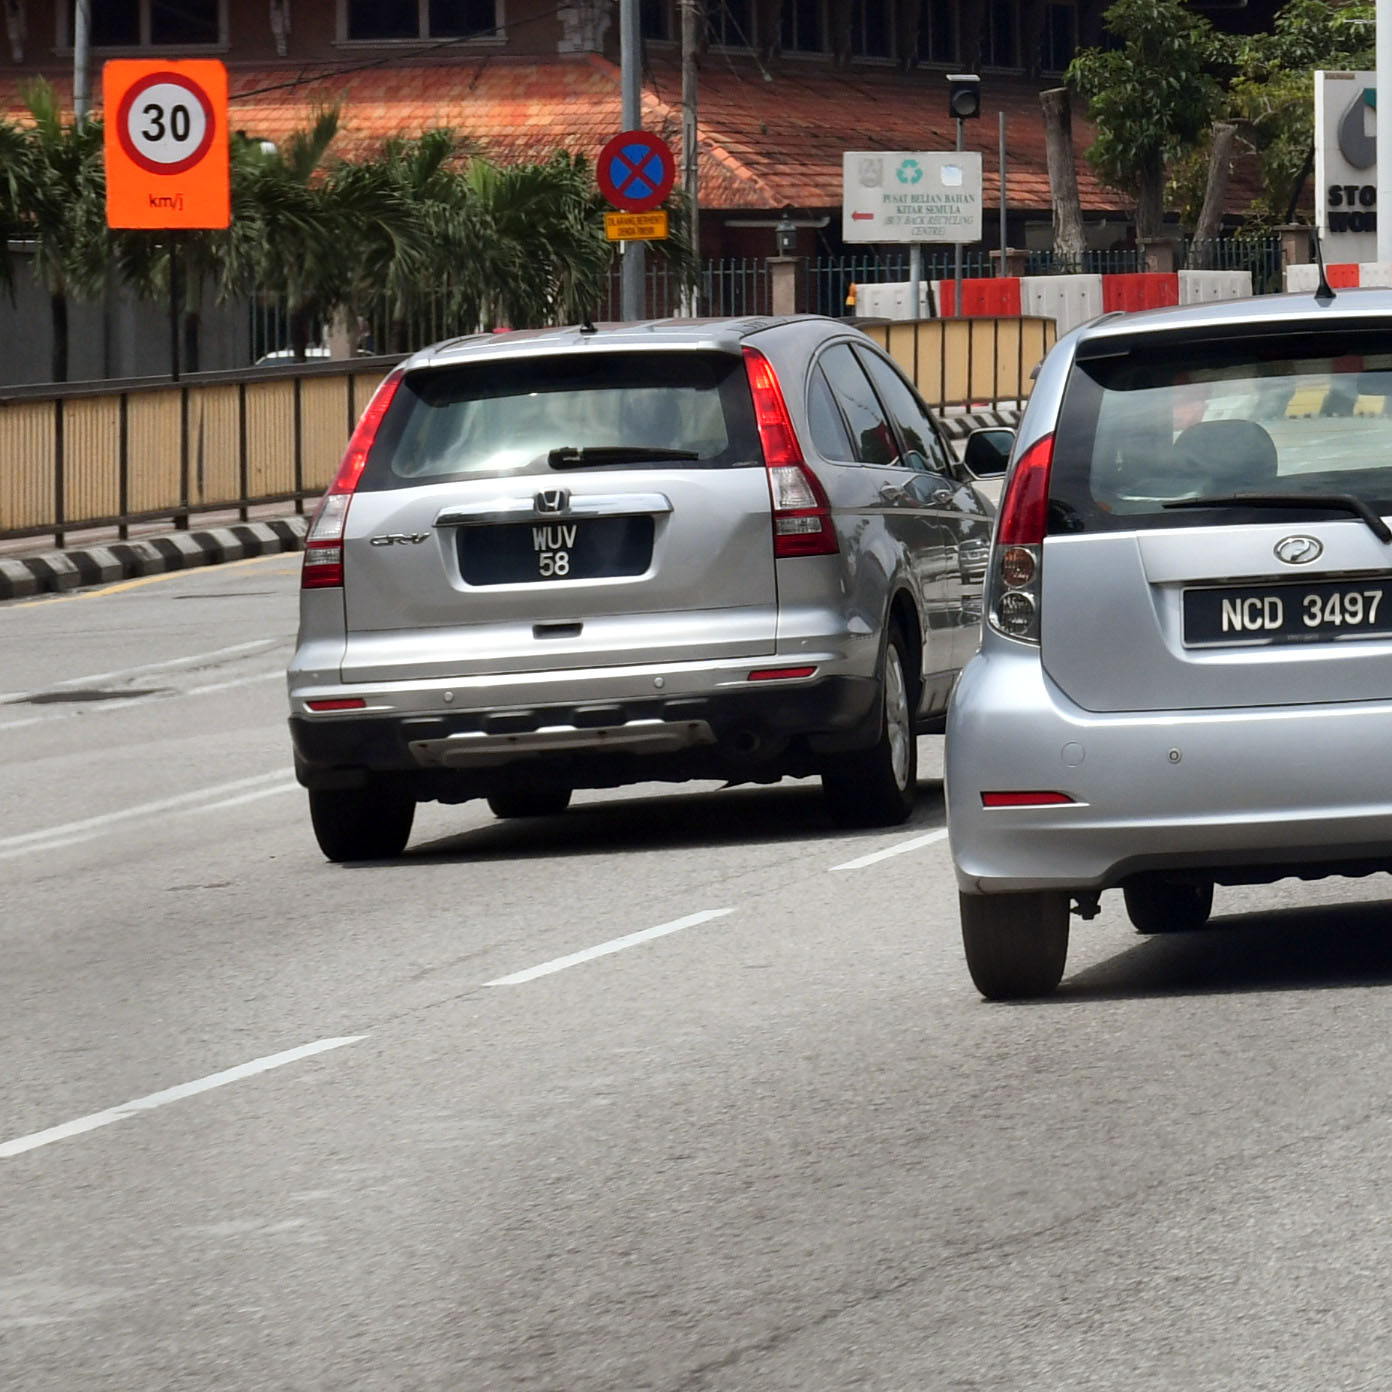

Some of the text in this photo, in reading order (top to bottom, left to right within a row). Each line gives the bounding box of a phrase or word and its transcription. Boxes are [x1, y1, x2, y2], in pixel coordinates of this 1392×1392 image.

[142, 103, 190, 142] 30
[149, 193, 184, 211] km/j
[883, 194, 976, 204] PUSAT BELIAN BAHAN
[1327, 184, 1376, 207] STO
[896, 205, 961, 214] KITAR SEMULA
[532, 524, 578, 552] WUV
[539, 551, 570, 577] 58
[1221, 590, 1384, 632] NCD 3497
